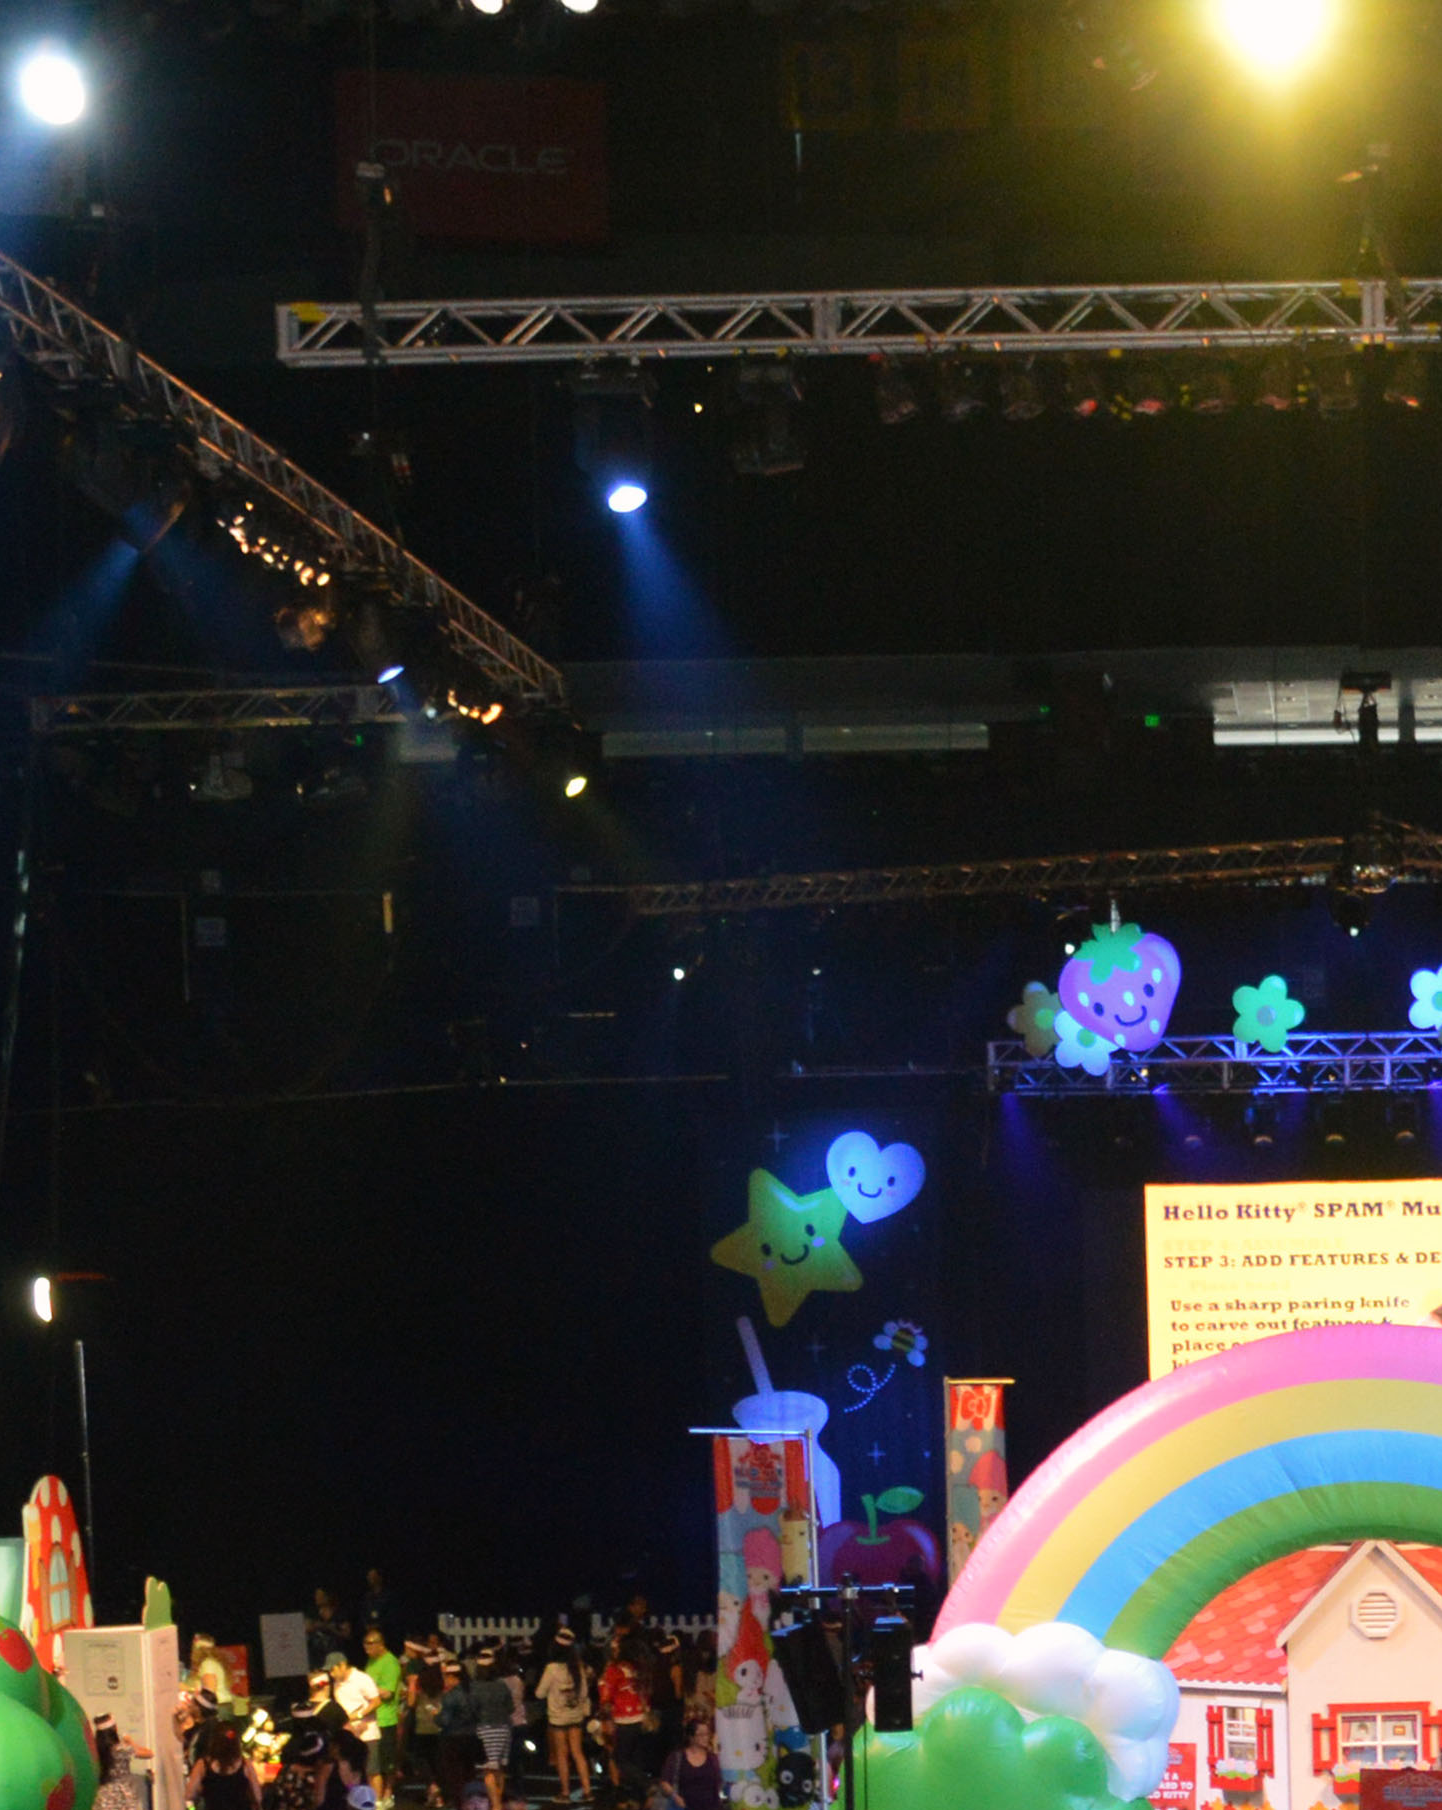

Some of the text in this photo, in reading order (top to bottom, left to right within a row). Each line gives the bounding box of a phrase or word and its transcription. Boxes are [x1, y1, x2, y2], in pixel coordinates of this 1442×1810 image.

[371, 138, 570, 176] ORACLE
[1163, 1205, 1228, 1221] Hello
[1164, 1256, 1212, 1268] STEP
[1242, 1254, 1283, 1267] ADD
[1290, 1253, 1389, 1266] FEATURES
[1396, 1253, 1408, 1263] &
[1170, 1295, 1410, 1315] Use a sharp paring knife
[1171, 1320, 1191, 1332] to
[1195, 1320, 1249, 1332] carve
[1255, 1319, 1287, 1331] out
[1172, 1340, 1234, 1355] place
